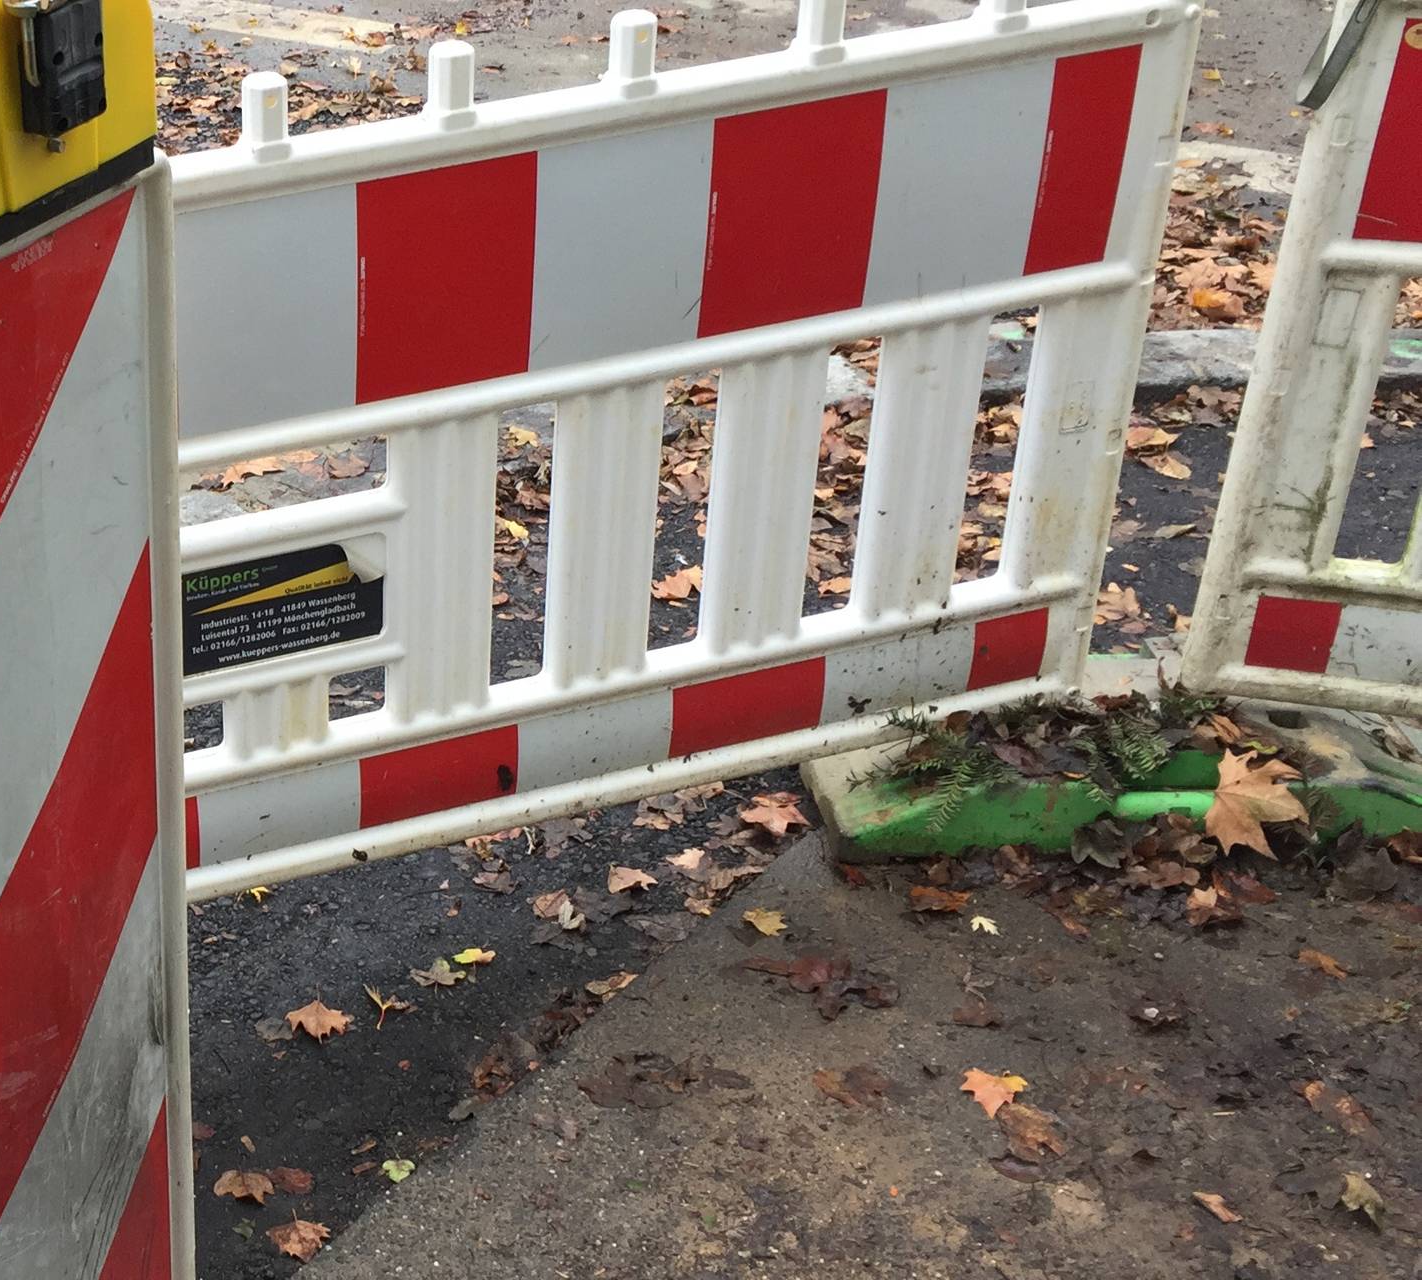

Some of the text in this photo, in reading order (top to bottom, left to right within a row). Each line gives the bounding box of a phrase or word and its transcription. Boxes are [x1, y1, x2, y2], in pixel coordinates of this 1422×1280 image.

[185, 567, 260, 593] Küppers
[284, 583, 312, 595] Qualität
[200, 591, 356, 630] Industriestr. 14-18 41849 Wassenberg
[201, 602, 356, 641] Luisental 73 41199 Mönchengladbach
[282, 625, 299, 635] Fax:
[218, 630, 340, 663] www.kueppers-wassenberg.de
